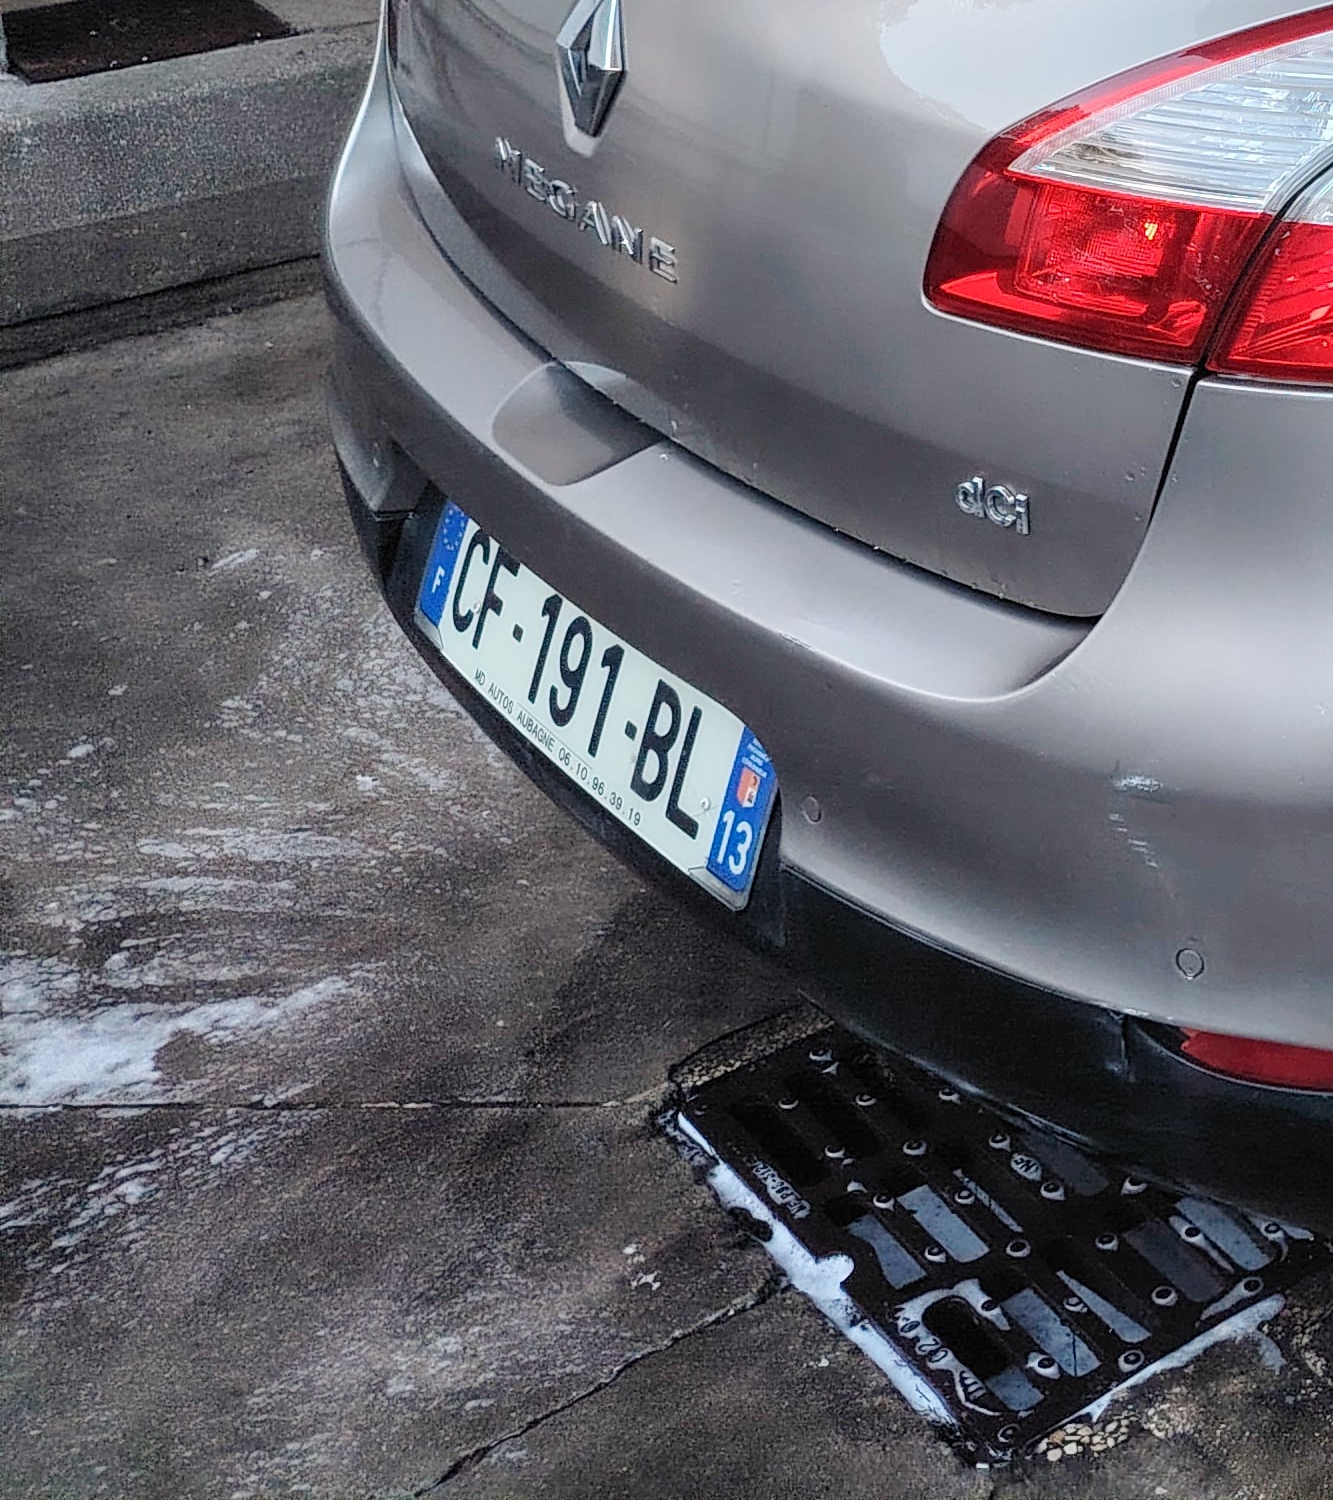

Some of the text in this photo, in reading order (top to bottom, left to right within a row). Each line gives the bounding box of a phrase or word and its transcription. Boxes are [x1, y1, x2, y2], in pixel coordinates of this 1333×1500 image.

[495, 136, 680, 284] MEGANE
[431, 565, 446, 594] F
[452, 528, 702, 841] CF-191-BL
[474, 668, 641, 826] MD AUTOS AUBAGNE 06.10.96.39.19
[716, 809, 753, 877] 13
